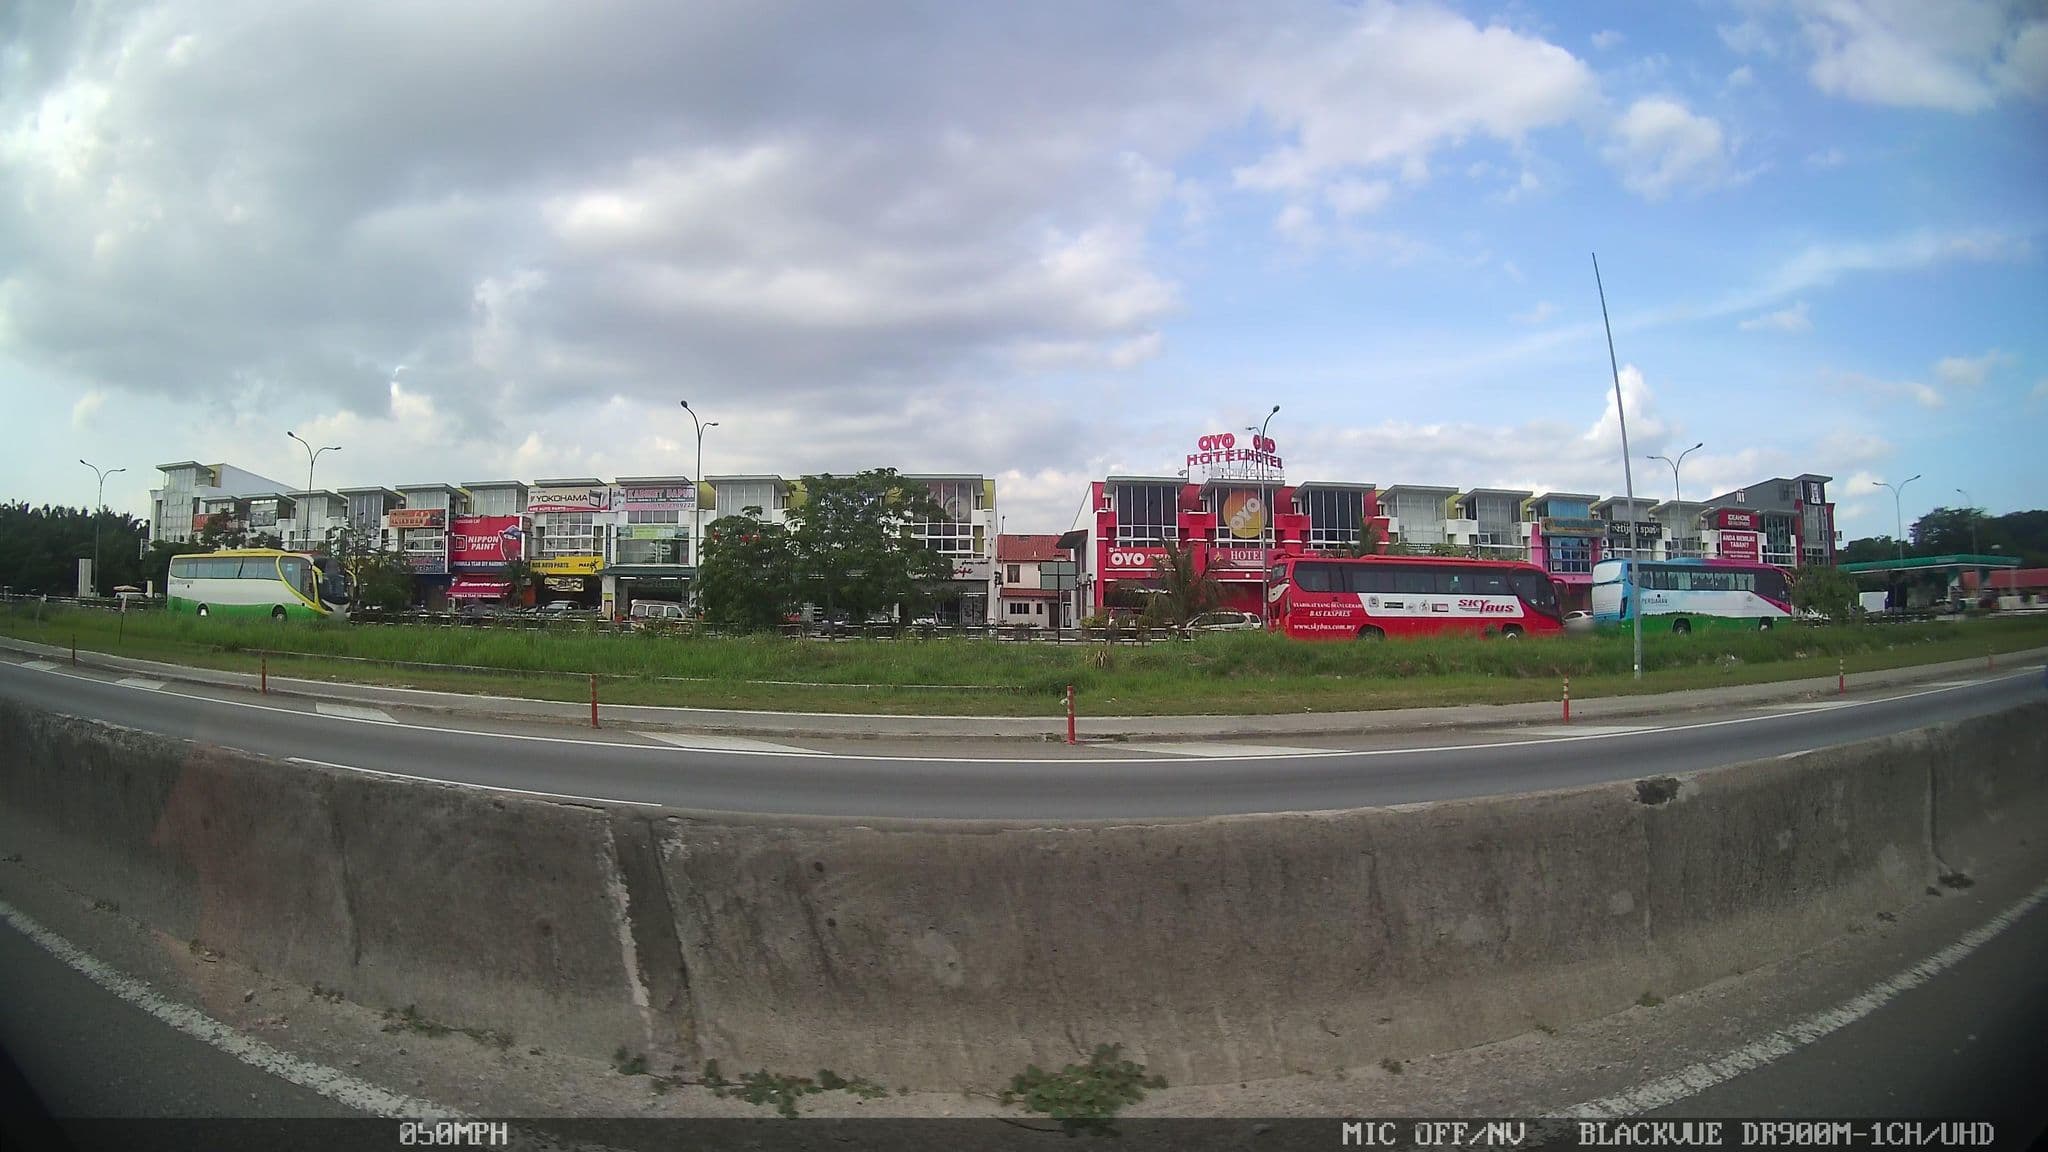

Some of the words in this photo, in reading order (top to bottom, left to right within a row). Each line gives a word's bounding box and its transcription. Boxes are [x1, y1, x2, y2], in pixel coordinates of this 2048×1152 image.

[1198, 432, 1235, 451] OYO
[1186, 449, 1246, 466] HOTEL
[536, 494, 588, 502] YOKOHAMA
[467, 535, 499, 543] NIPPON
[470, 543, 497, 551] PAINT
[1111, 552, 1145, 566] OYO
